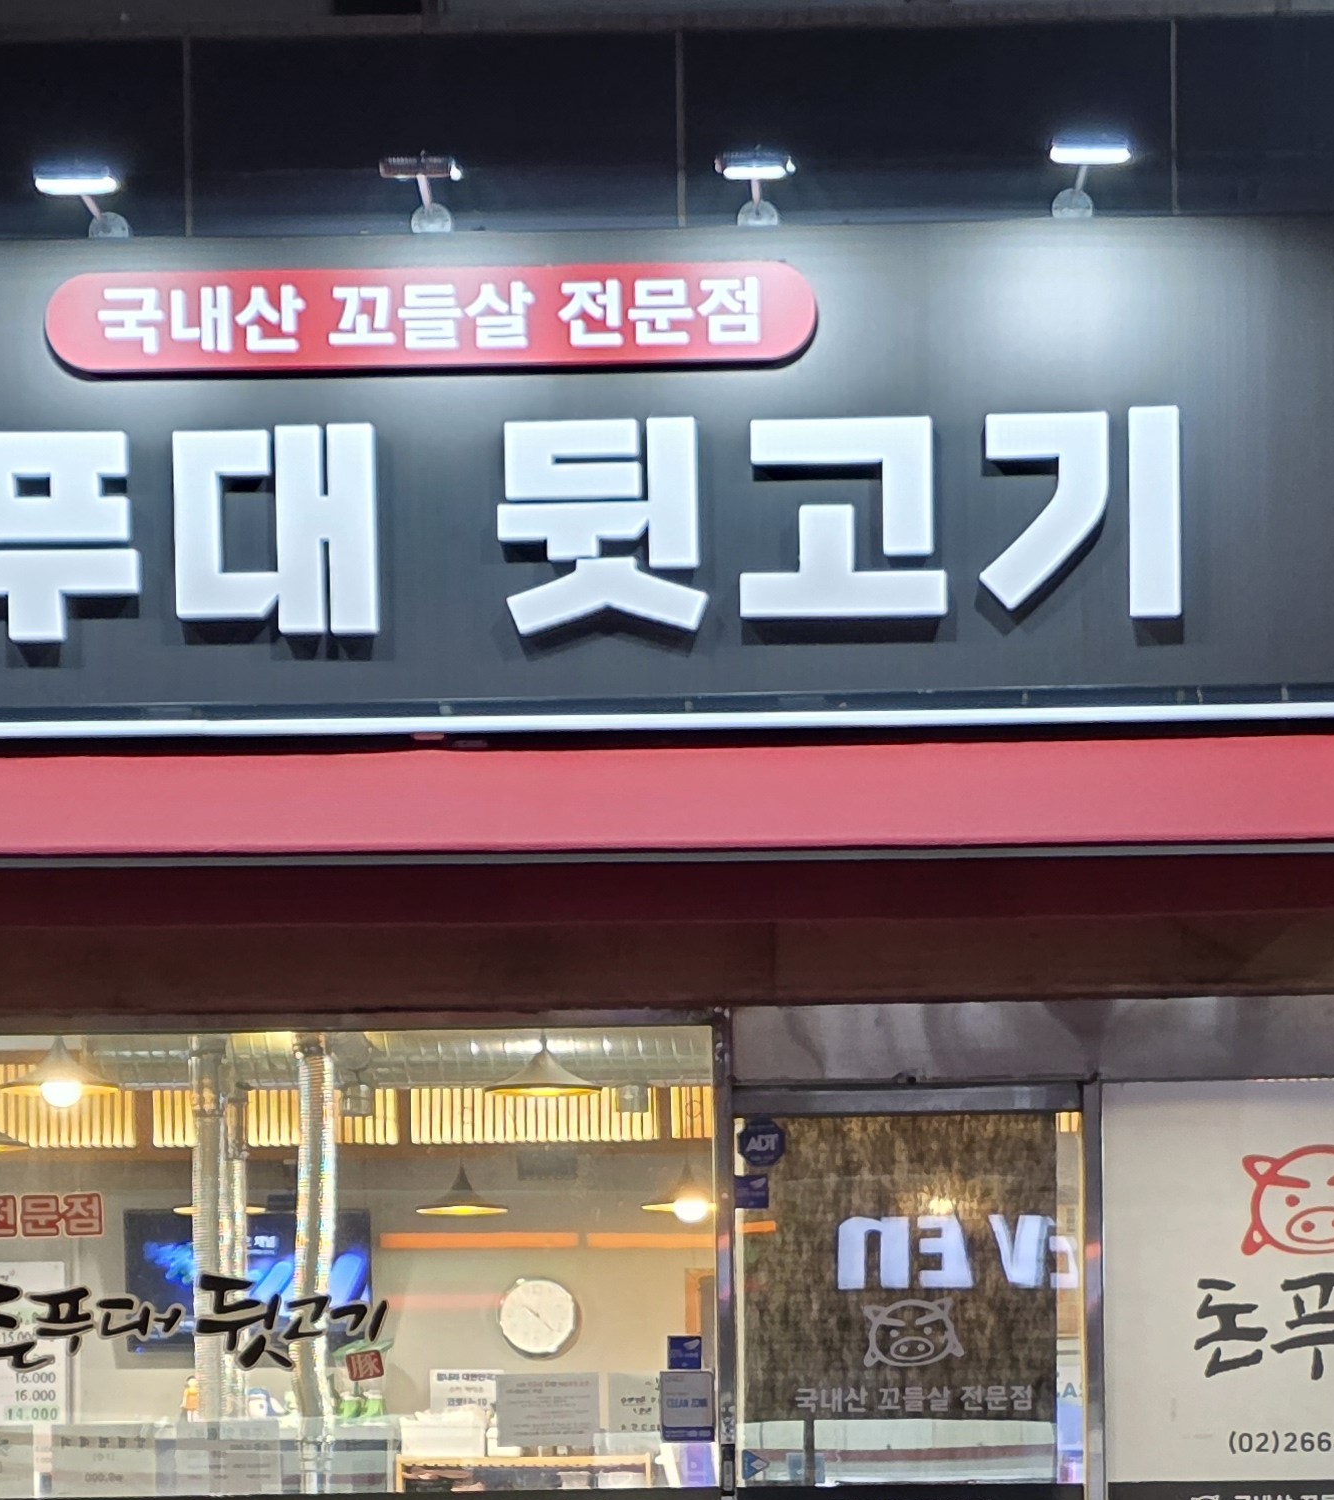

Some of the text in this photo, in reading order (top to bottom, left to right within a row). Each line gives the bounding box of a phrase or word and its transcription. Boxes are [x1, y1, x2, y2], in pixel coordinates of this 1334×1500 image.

[96, 275, 761, 354] 국내산 꼬들살 전문점
[497, 404, 1183, 635] 뒷고기
[745, 1133, 779, 1152] ADT
[194, 1272, 391, 1371] 뒷고기
[795, 1387, 868, 1413] 국내산
[877, 1385, 951, 1412] 꼬들살
[960, 1384, 1034, 1411] 전문점
